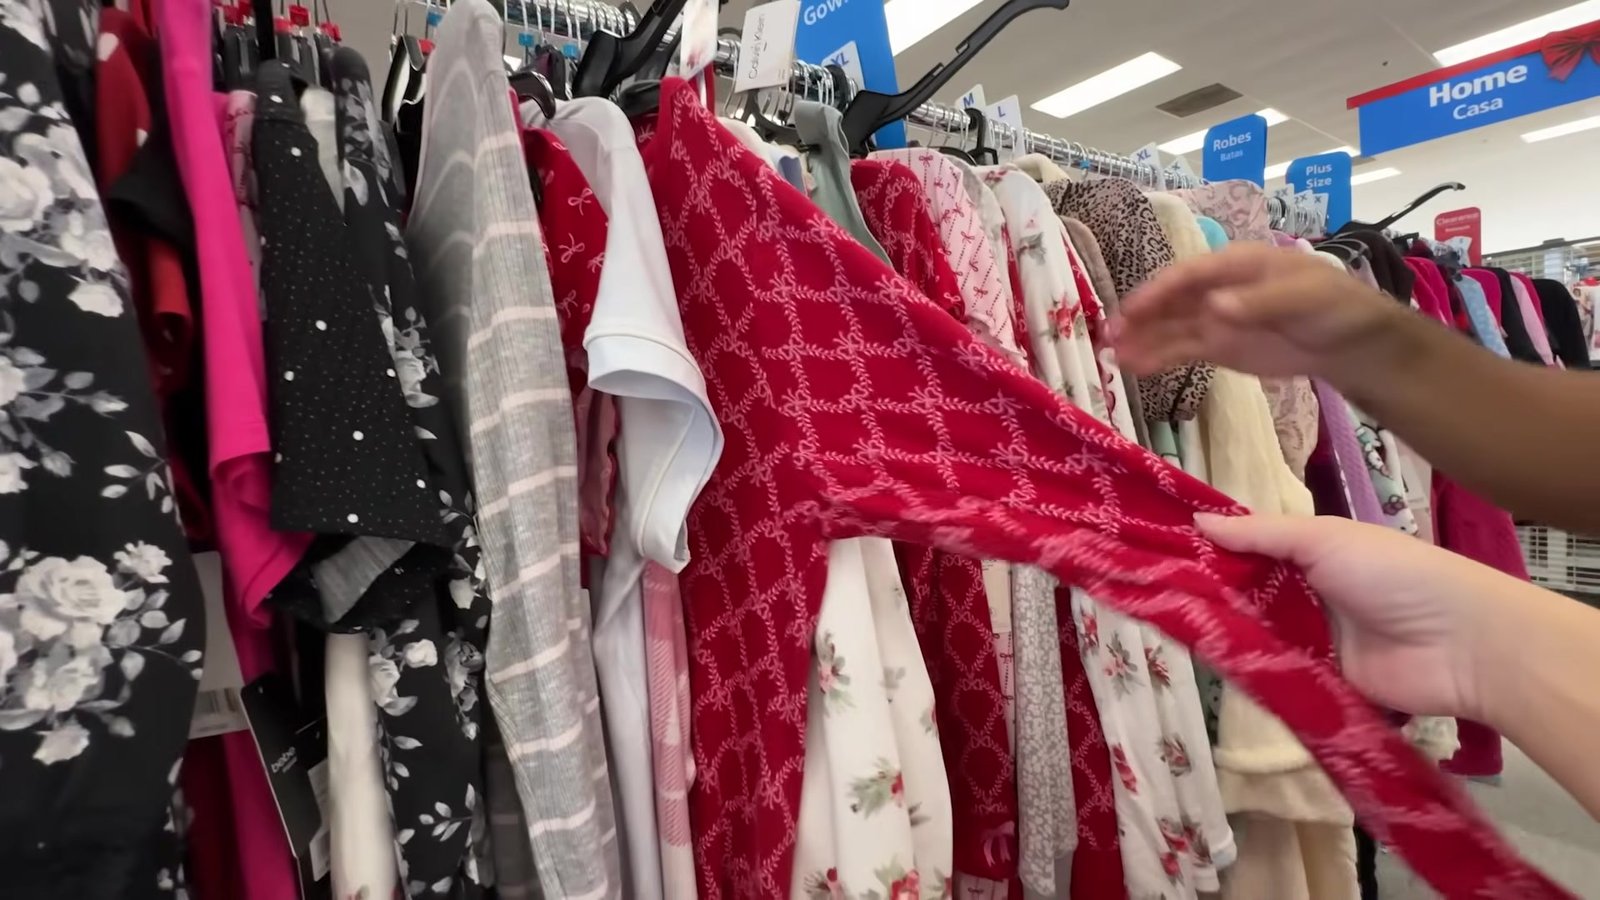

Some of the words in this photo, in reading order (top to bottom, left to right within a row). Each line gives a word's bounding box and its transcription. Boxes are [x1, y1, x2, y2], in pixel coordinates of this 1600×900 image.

[803, 0, 849, 26] Gow
[754, 13, 766, 42] Klein
[748, 43, 762, 80] Calvin
[1429, 65, 1528, 108] Home
[963, 92, 975, 109] M
[1453, 97, 1503, 120] Casa
[997, 105, 1006, 118] L
[1213, 131, 1252, 152] Robes
[1136, 149, 1152, 161] XL
[1220, 150, 1244, 162] Batas
[1305, 164, 1332, 176] Plus
[1305, 177, 1332, 189] Size
